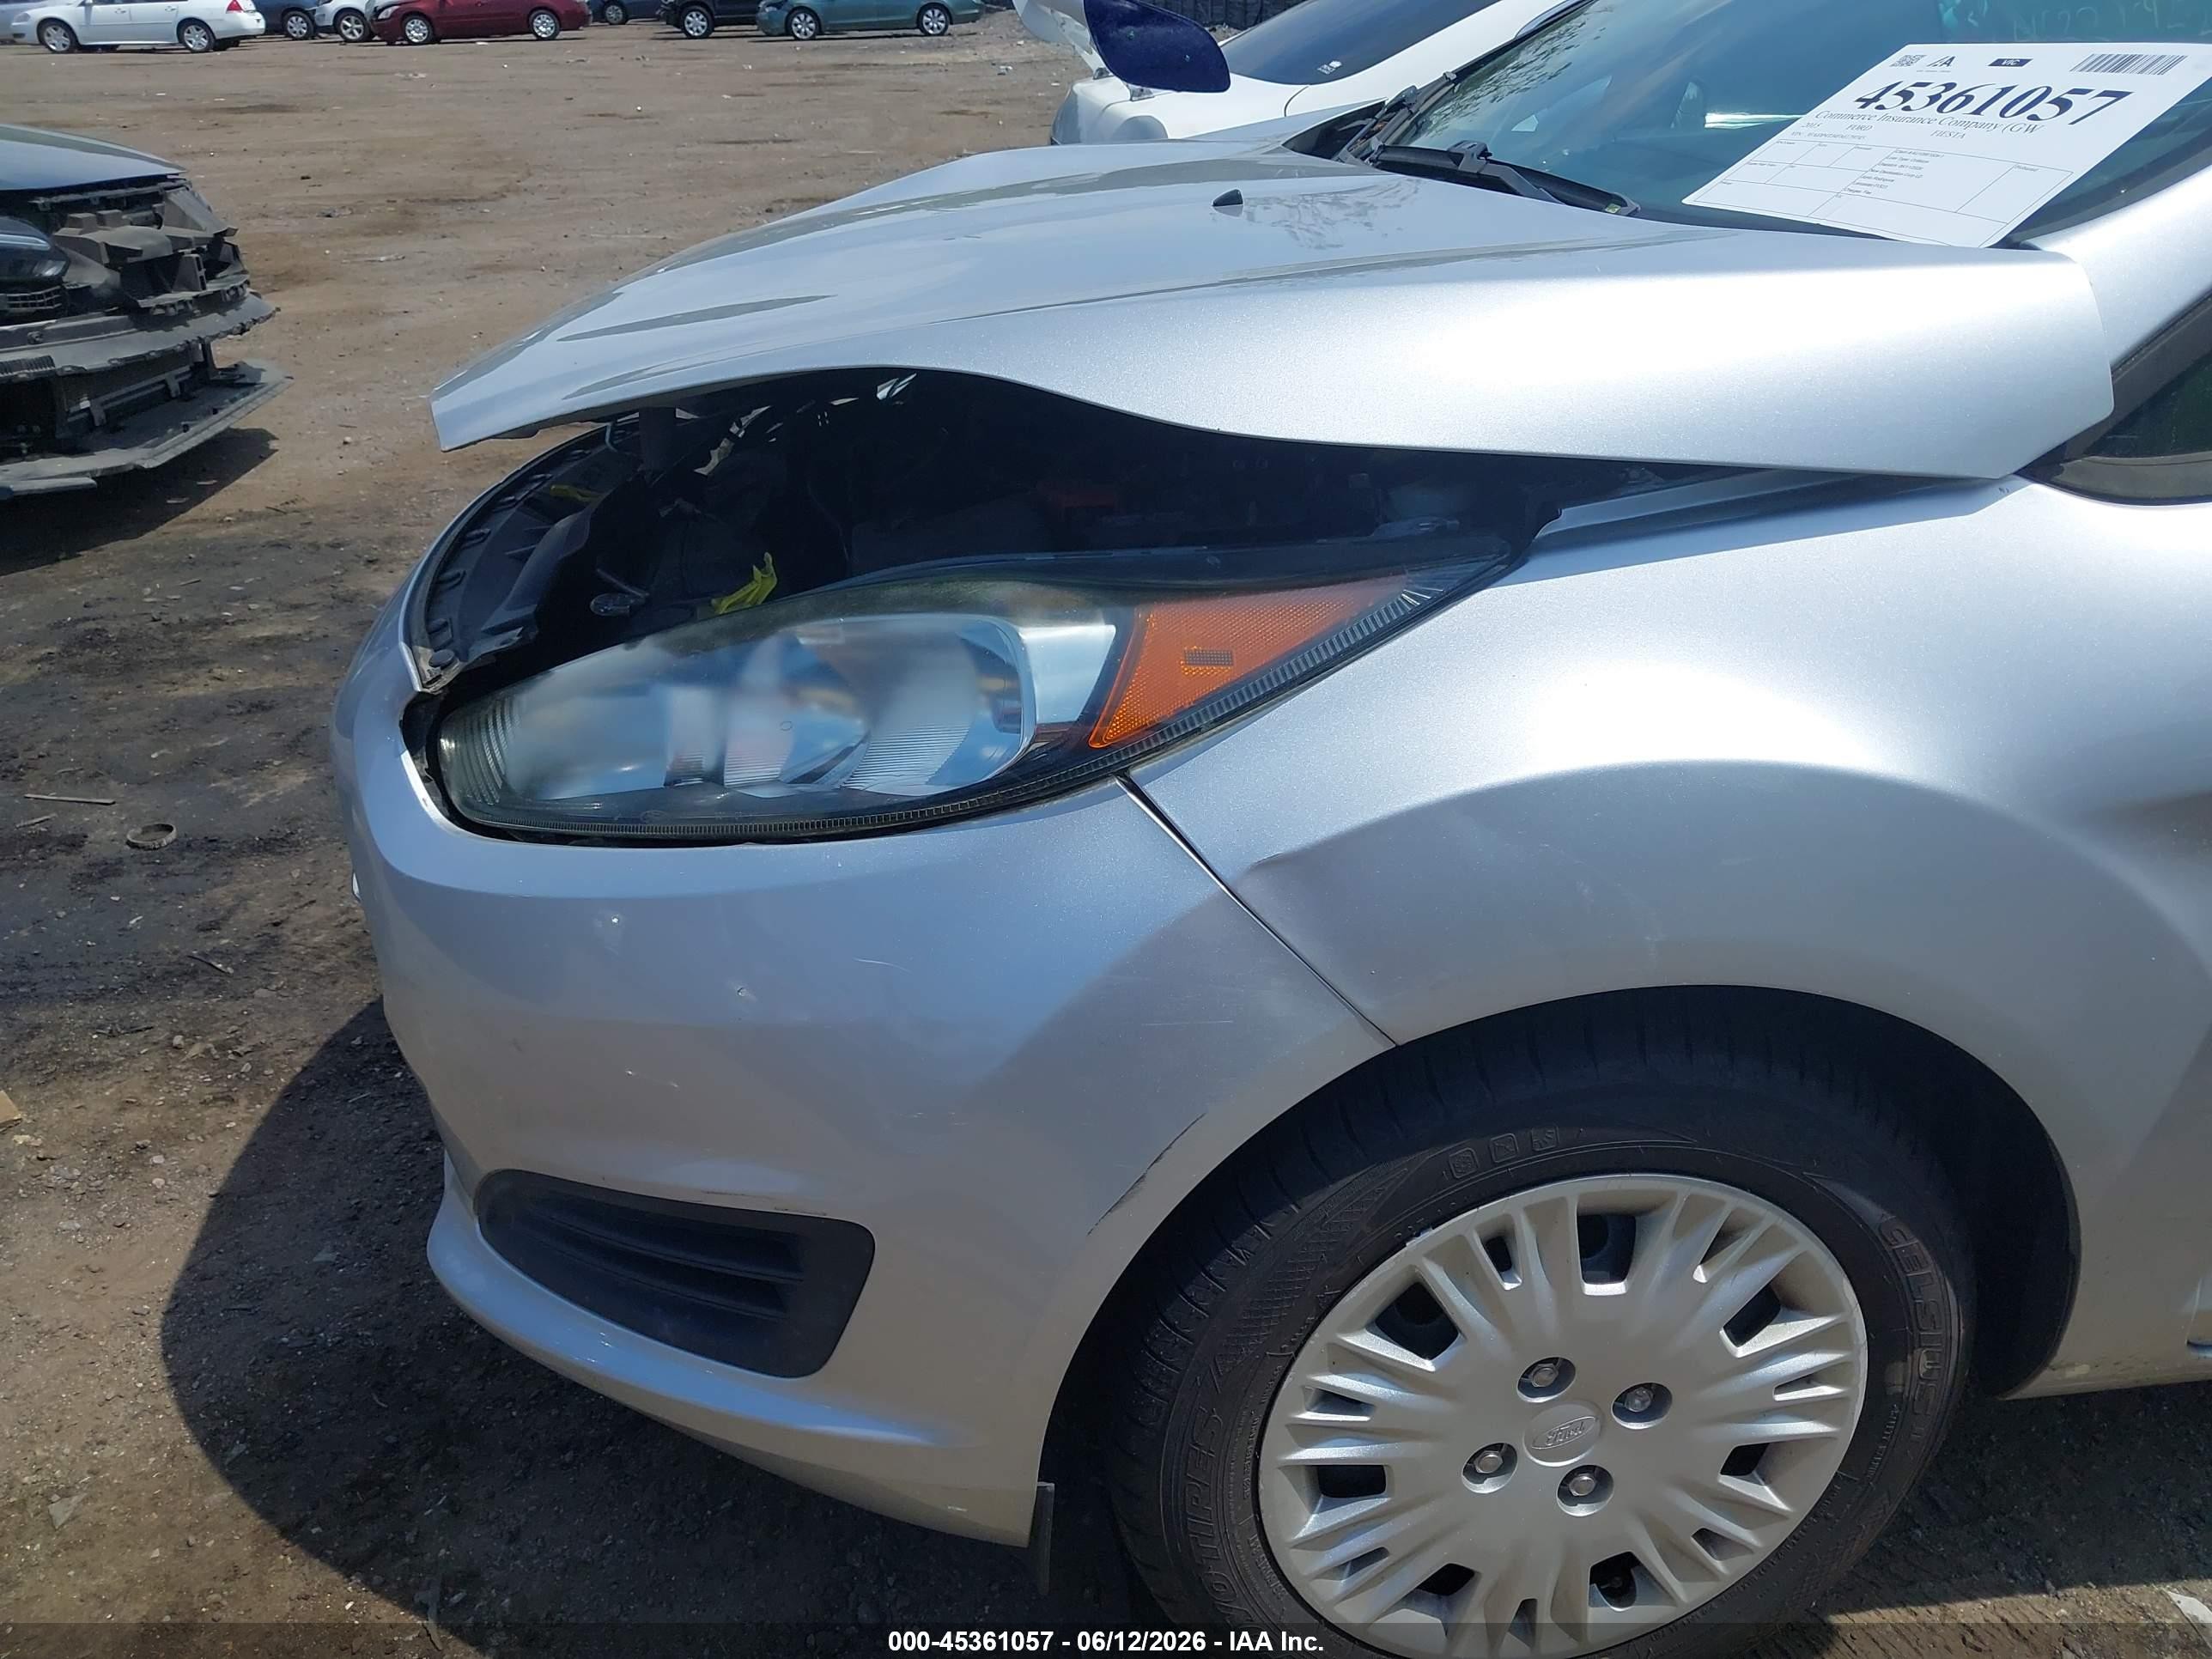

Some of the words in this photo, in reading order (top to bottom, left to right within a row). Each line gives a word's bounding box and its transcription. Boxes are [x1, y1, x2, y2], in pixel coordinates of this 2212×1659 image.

[1854, 81, 2136, 125] 45361057
[1814, 110, 1878, 121] Commerce
[1876, 112, 1938, 125] Insurance
[1937, 116, 2005, 132] Company
[2002, 123, 2045, 134] (GW
[1930, 130, 1966, 139] FIESTA
